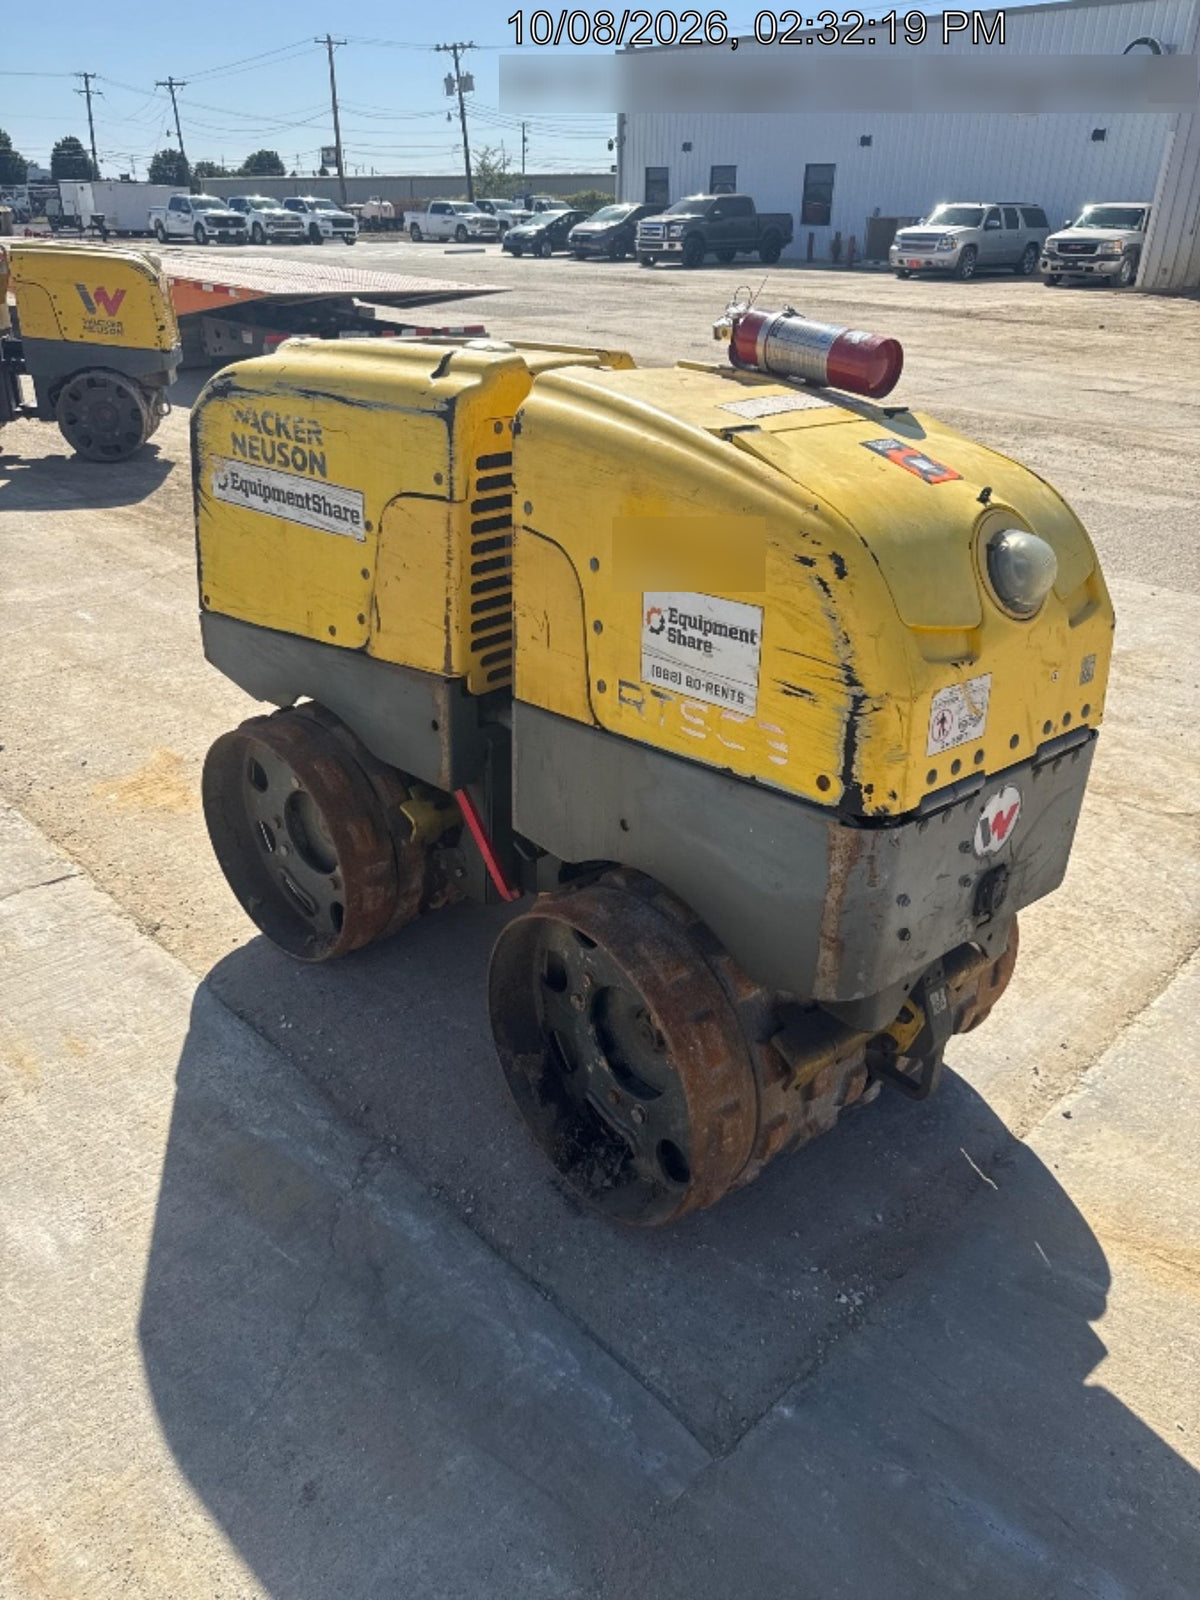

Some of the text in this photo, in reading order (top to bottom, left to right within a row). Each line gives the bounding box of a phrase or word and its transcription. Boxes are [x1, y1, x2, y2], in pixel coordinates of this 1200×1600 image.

[230, 431, 328, 479] NEUSON
[230, 471, 361, 525] EquipmentShare
[667, 606, 758, 646] Equipment
[667, 627, 713, 654] Share
